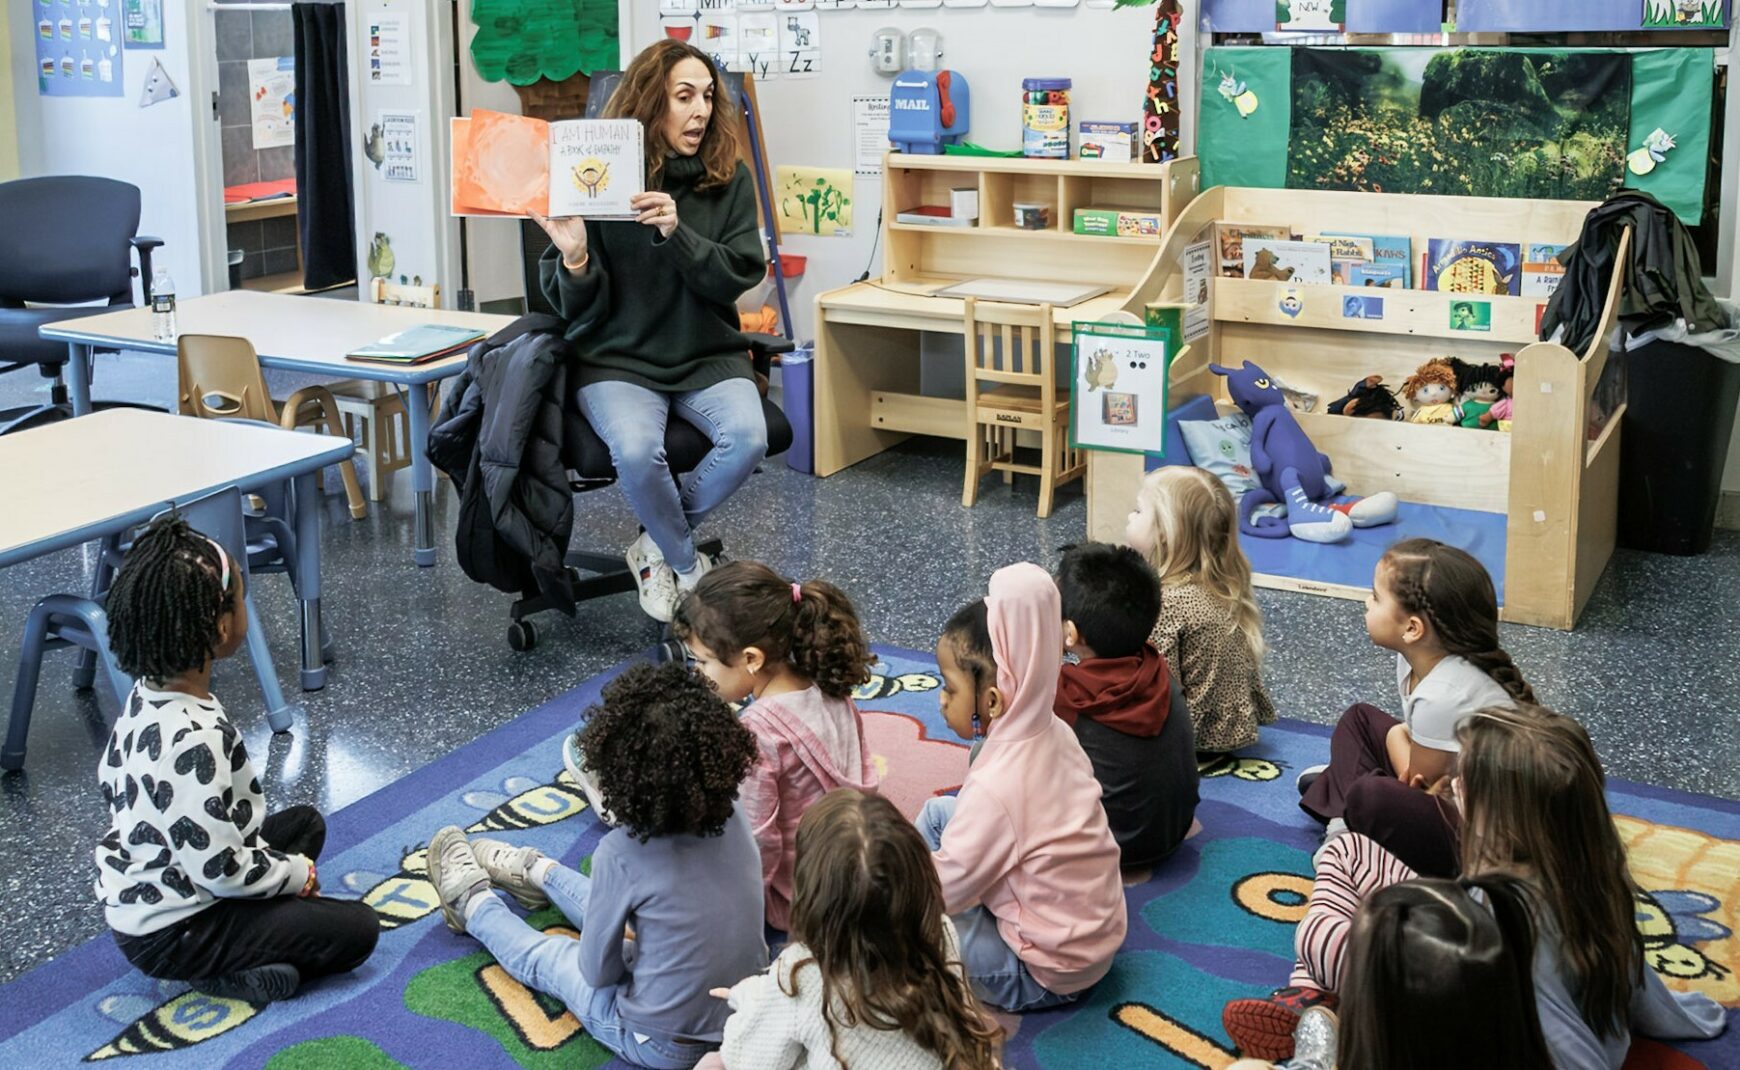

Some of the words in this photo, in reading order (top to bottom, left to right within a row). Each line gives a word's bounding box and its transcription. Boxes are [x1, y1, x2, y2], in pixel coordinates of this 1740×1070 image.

[749, 52, 769, 79] Yy
[789, 51, 813, 73] Zz
[894, 98, 930, 111] MAIL
[561, 125, 580, 142] AM
[584, 123, 630, 143] HUMAN
[1134, 350, 1151, 360] Two
